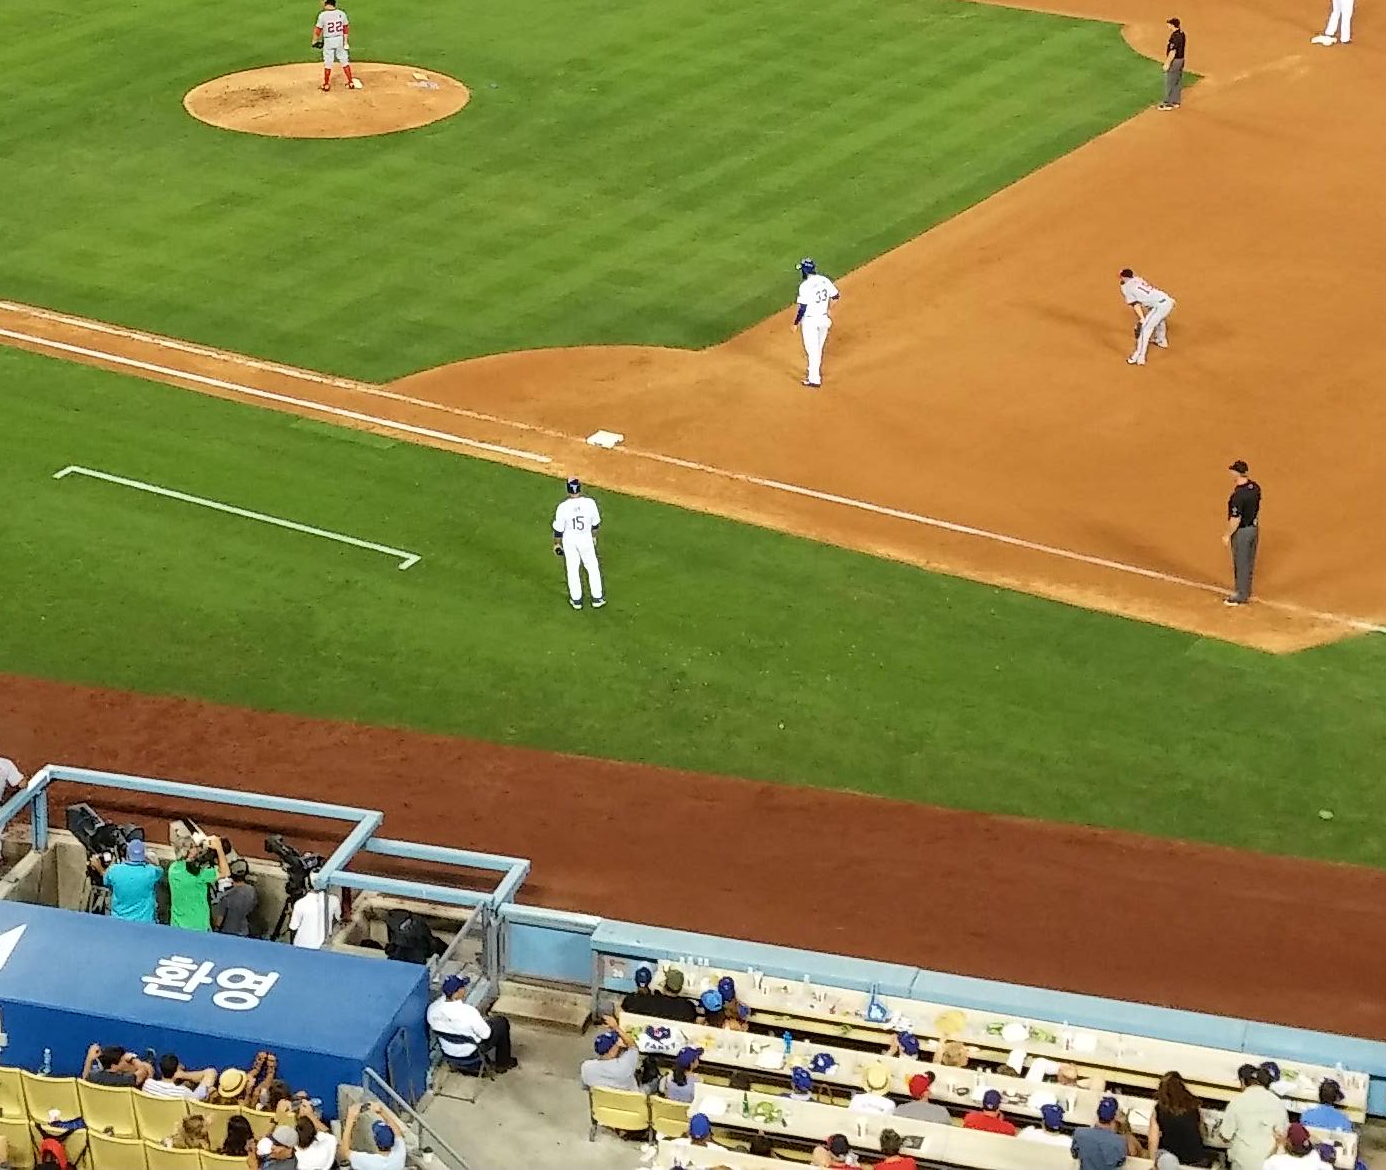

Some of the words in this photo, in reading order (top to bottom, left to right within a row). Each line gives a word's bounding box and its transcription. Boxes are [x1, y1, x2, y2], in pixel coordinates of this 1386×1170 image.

[326, 20, 343, 34] 22
[571, 516, 585, 531] 15
[140, 953, 282, 1012] 환영
